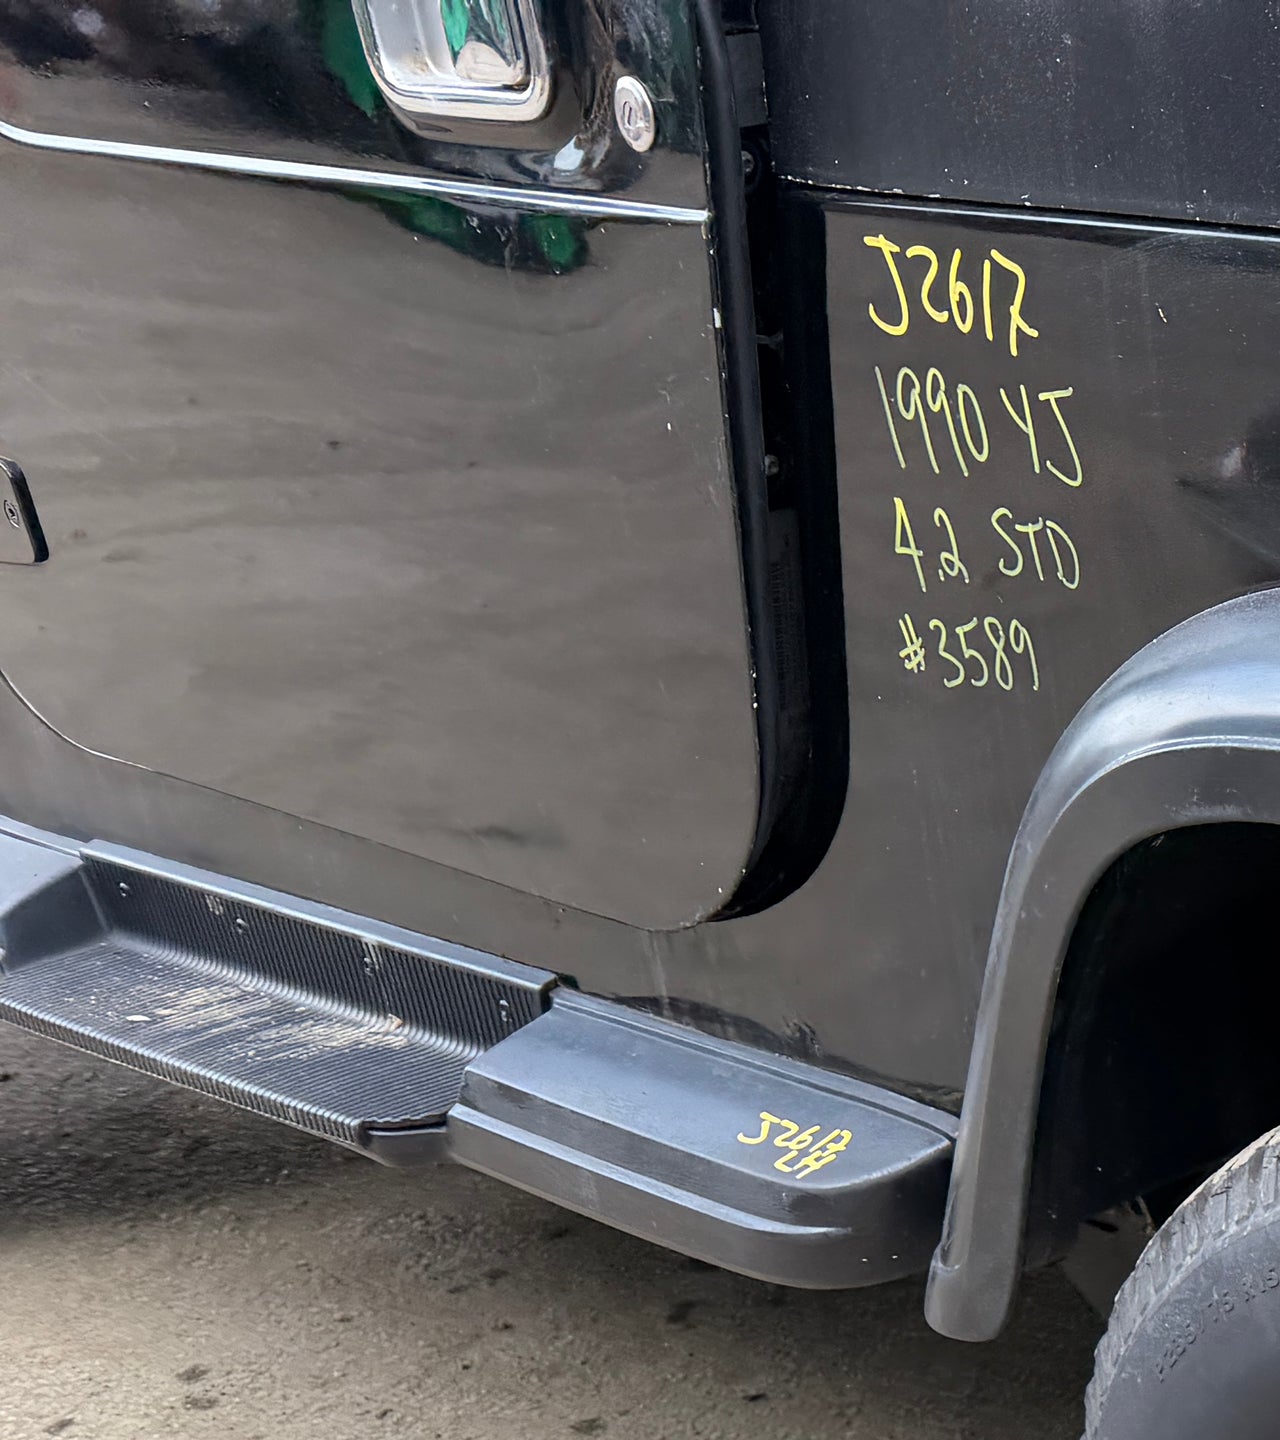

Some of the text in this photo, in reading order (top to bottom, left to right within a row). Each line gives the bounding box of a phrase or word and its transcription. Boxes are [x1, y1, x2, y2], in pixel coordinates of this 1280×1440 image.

[863, 234, 1039, 357] J2617
[874, 365, 1083, 488] 1990 YJ
[990, 506, 1081, 590] STD
[898, 612, 1040, 692] #3589
